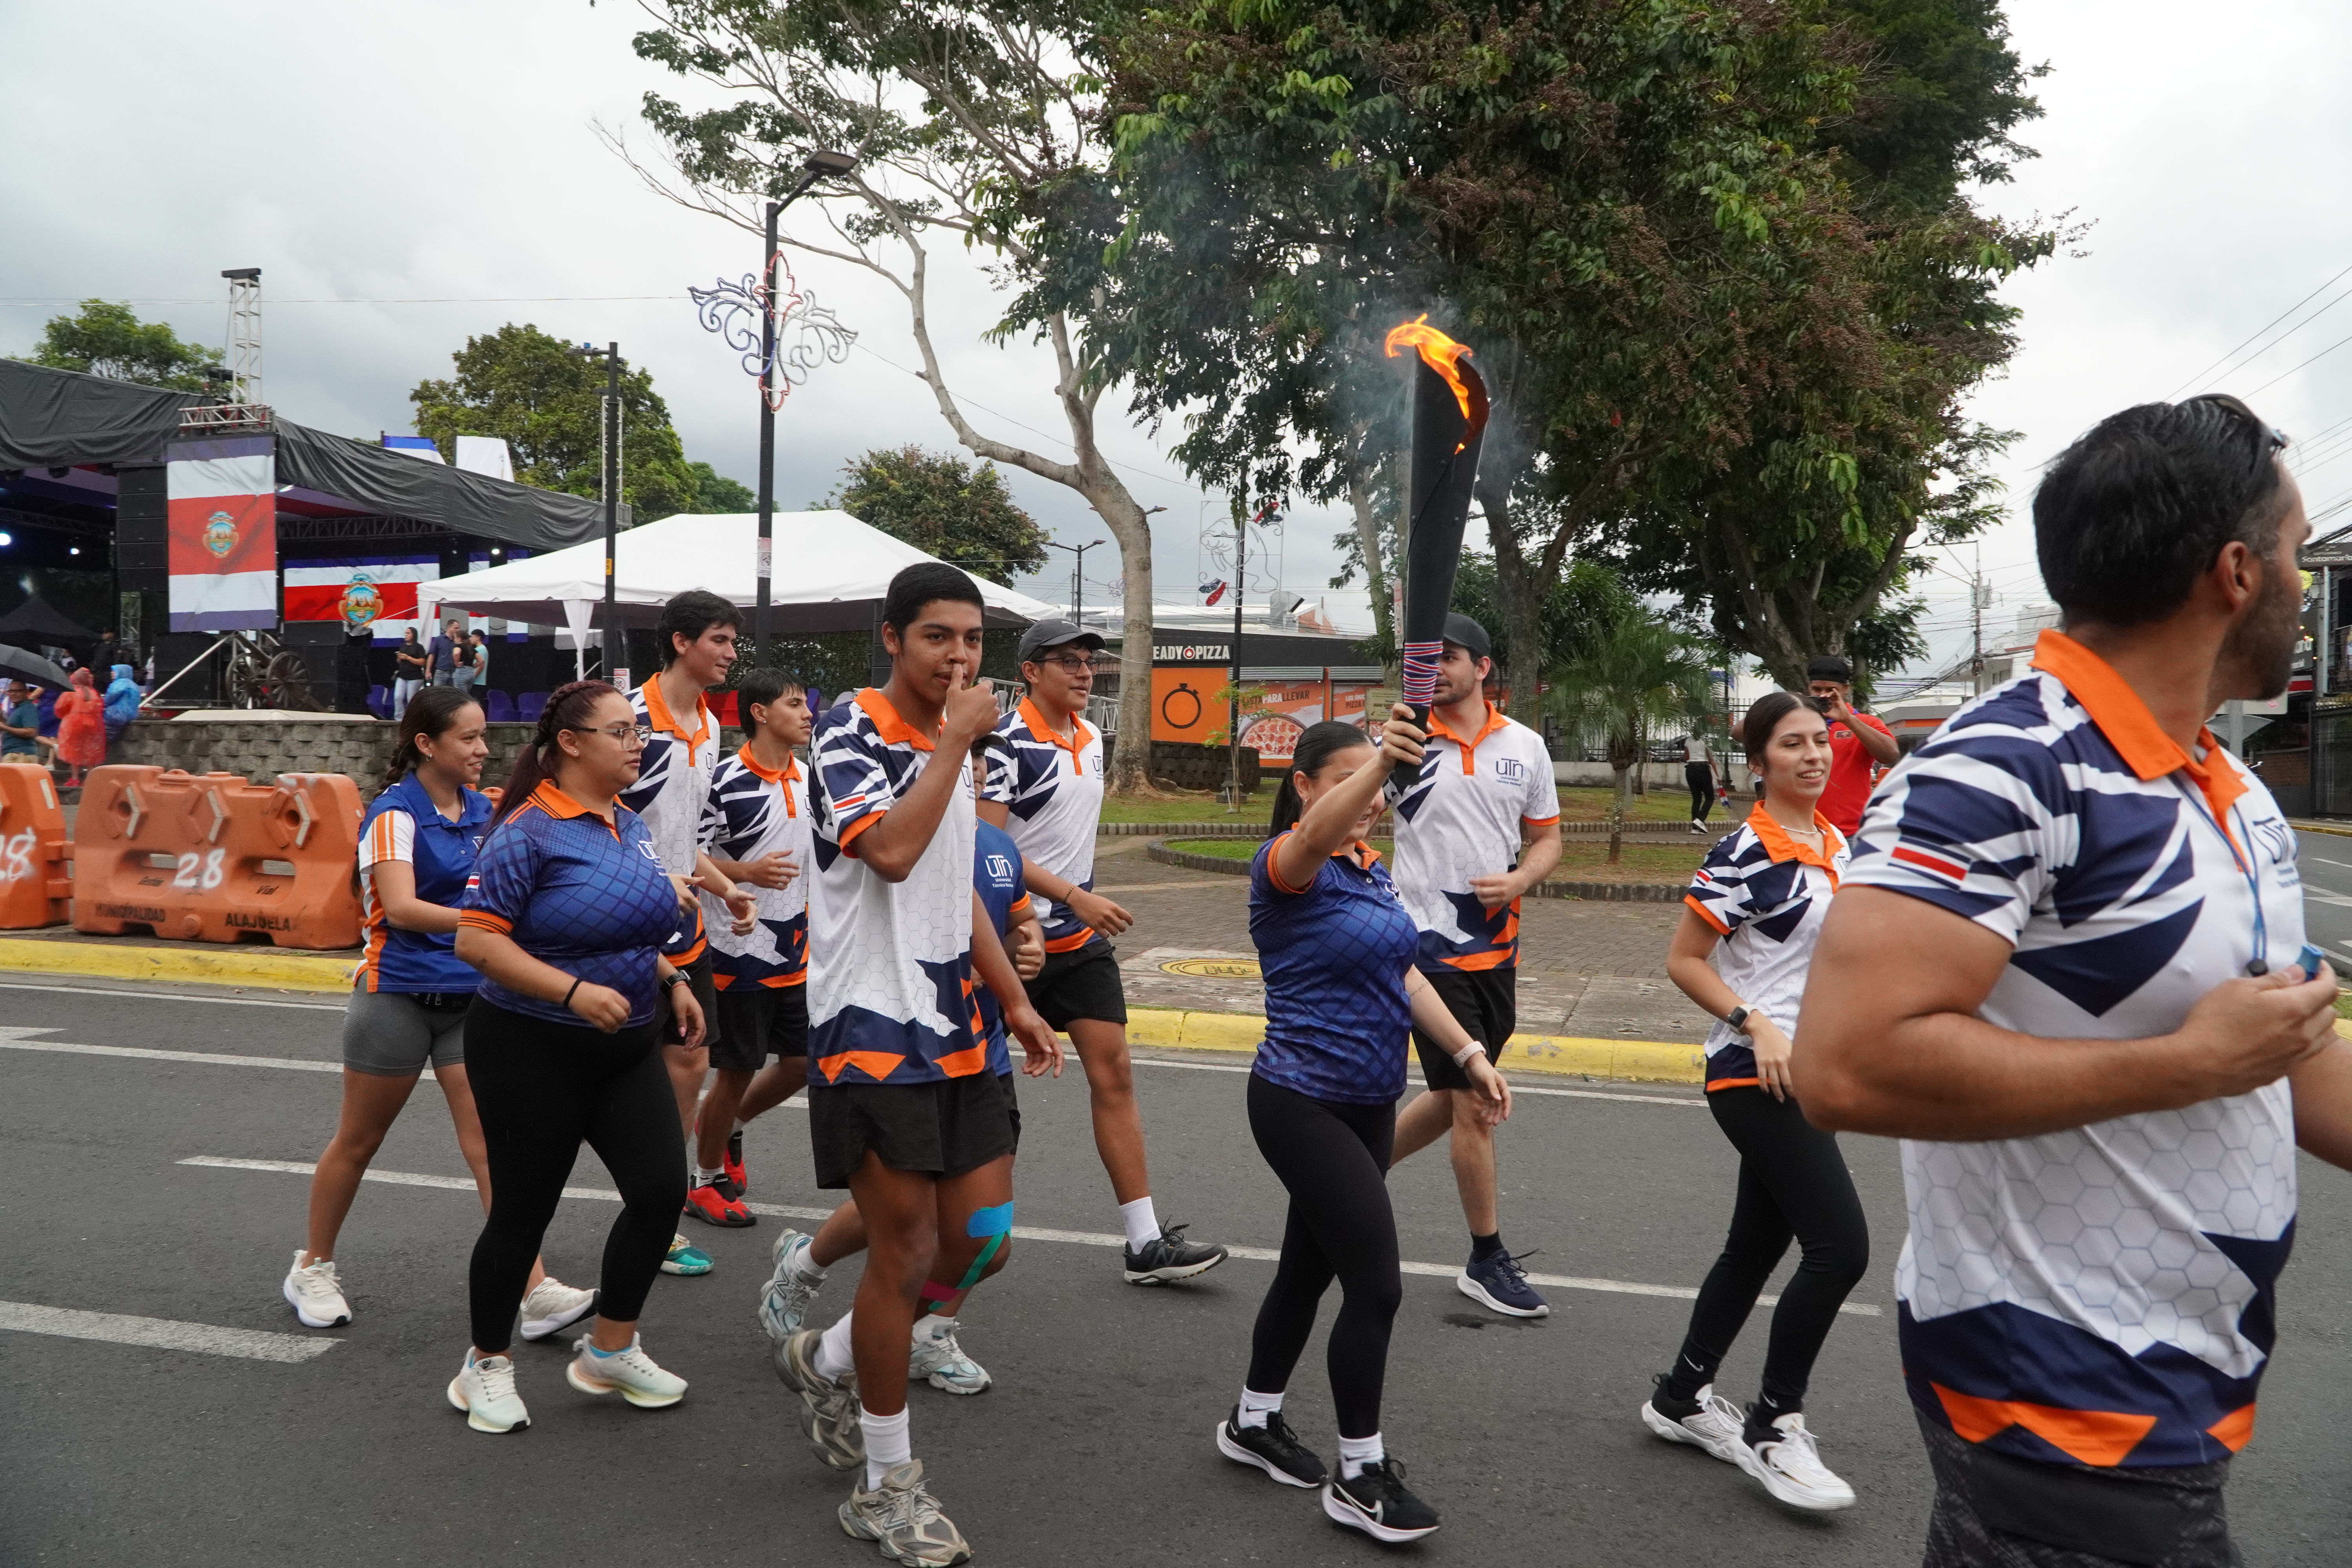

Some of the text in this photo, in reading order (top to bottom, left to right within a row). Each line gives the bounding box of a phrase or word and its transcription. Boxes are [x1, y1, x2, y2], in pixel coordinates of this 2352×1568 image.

[1153, 645, 1230, 660] EADY PIZZA
[1283, 690, 1310, 702] LLEVAR
[173, 848, 226, 889] 28
[225, 912, 291, 932] ALAJUELA
